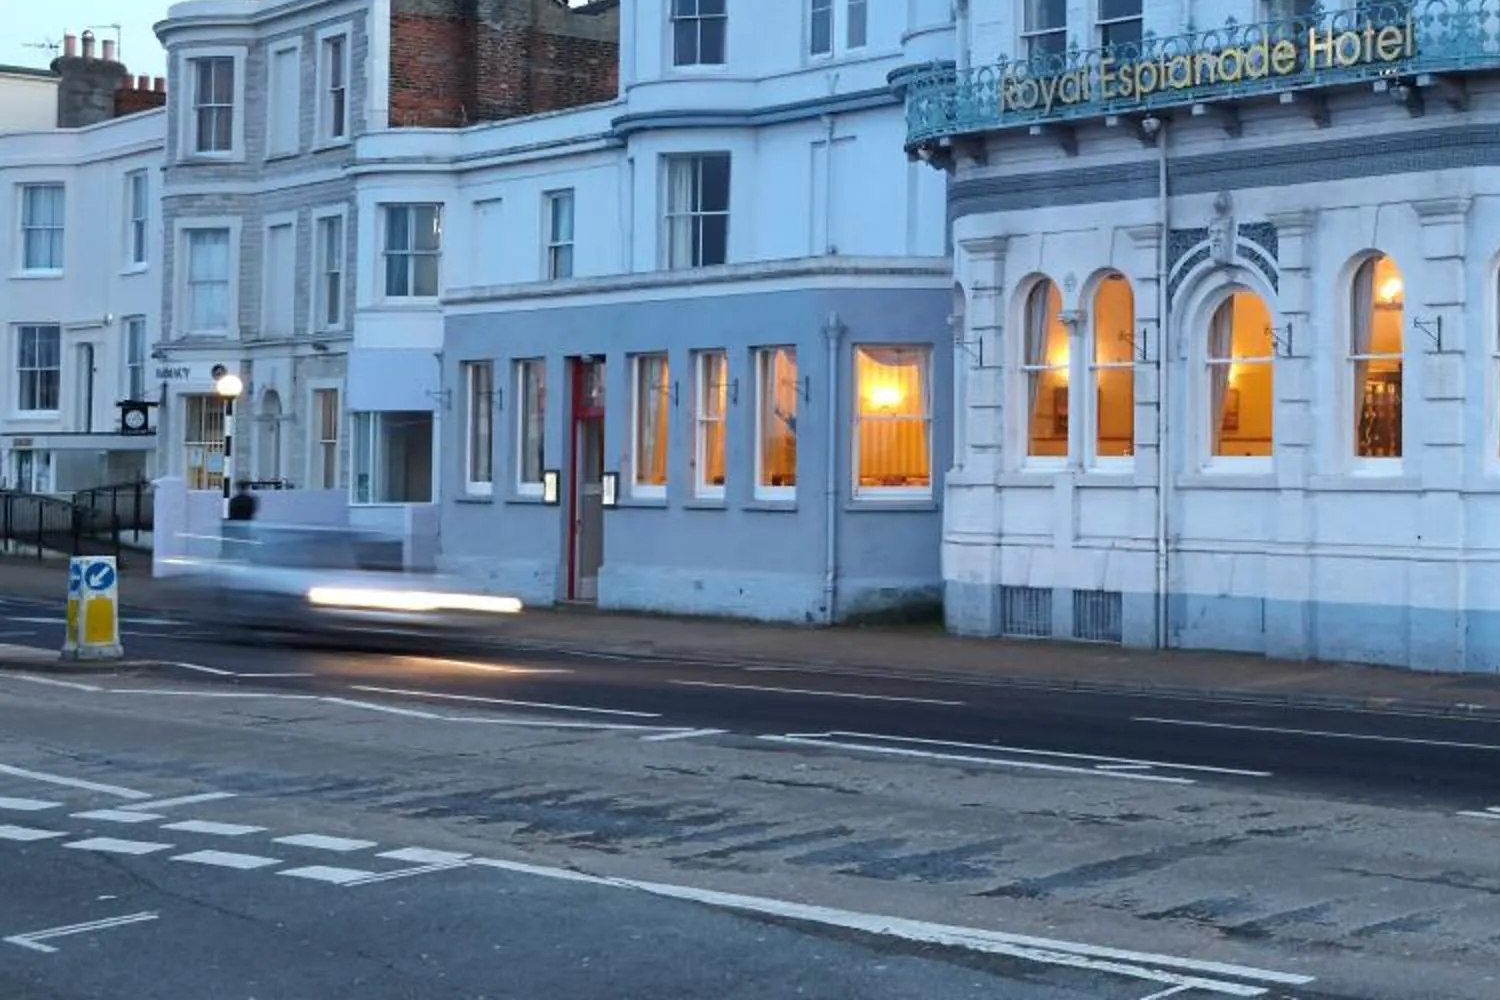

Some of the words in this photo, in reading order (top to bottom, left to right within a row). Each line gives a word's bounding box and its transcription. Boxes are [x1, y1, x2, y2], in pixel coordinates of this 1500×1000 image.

[1001, 63, 1090, 115] Royal
[1101, 27, 1298, 103] Esplanade
[1309, 11, 1414, 70] Hotel
